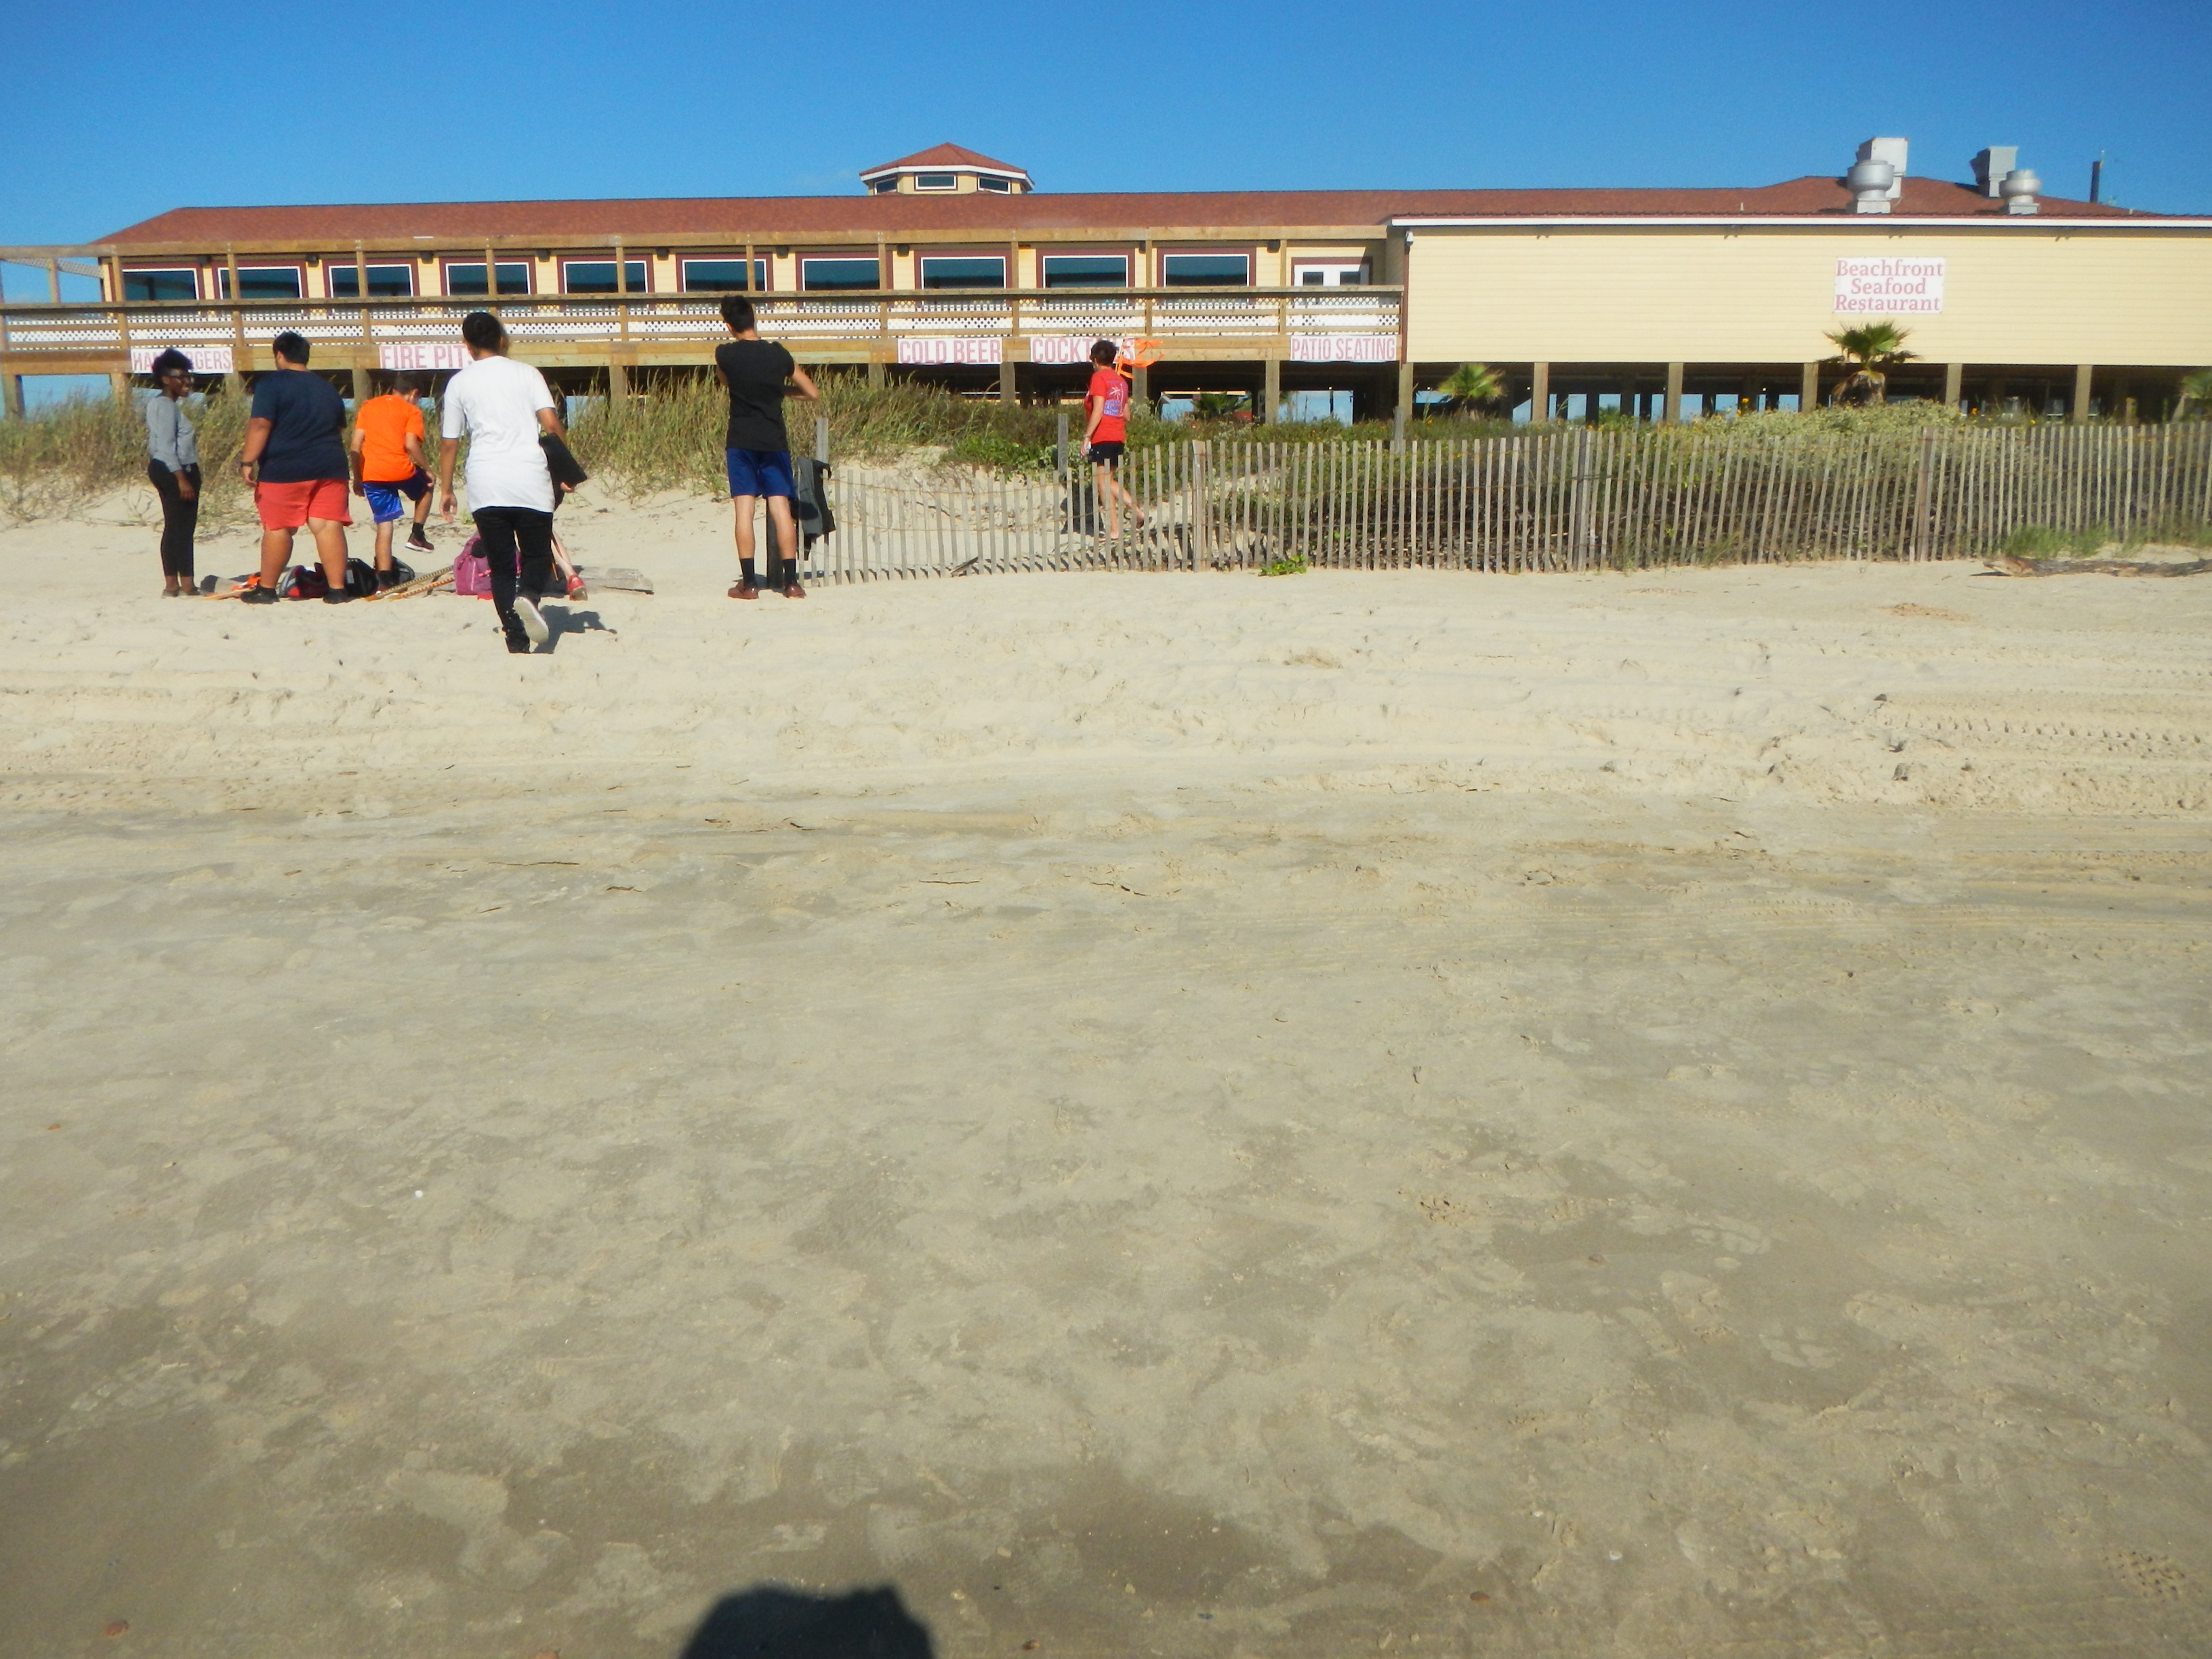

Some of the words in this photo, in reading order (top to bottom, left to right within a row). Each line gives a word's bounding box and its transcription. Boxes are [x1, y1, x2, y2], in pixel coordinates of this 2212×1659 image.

[1837, 260, 1943, 276] Beachfront
[1851, 277, 1927, 294] Seafood
[1835, 294, 1940, 311] Restaurant
[133, 350, 231, 371] HAGERS
[382, 345, 427, 369] FIRE
[434, 344, 472, 369] PIT
[899, 340, 947, 365] COLD
[954, 340, 1002, 364] BEER
[1032, 337, 1134, 363] COCKTS
[1292, 338, 1331, 361] PATIO
[1336, 338, 1395, 361] SEATING
